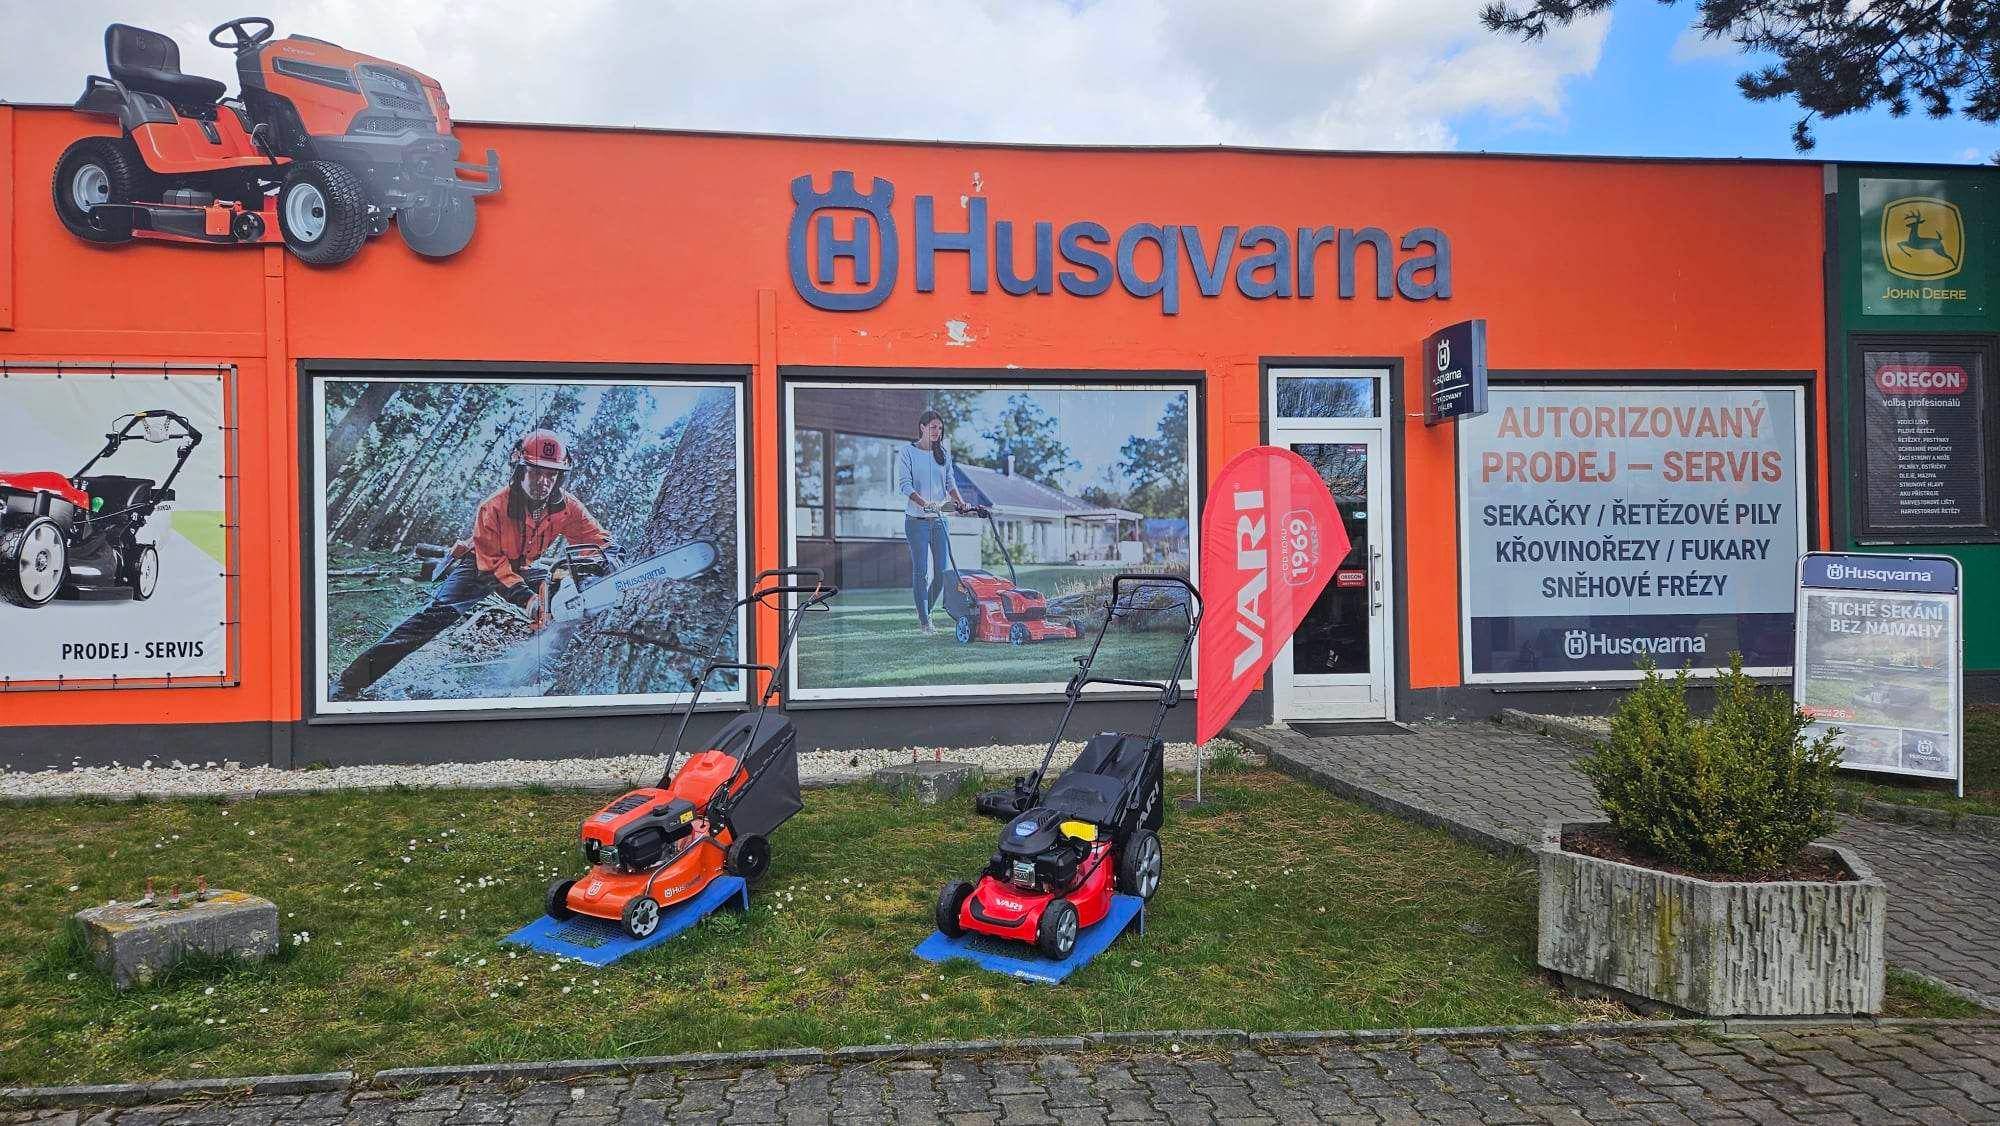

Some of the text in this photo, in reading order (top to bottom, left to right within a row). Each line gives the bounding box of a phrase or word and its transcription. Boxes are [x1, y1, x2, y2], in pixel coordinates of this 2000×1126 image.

[914, 194, 1452, 316] Husqvarna
[1882, 287, 1968, 300] JOHN DEERE
[1881, 371, 1960, 388] OREGON
[1883, 397, 1961, 409] volba profesionálů
[1497, 400, 1766, 438] AUTORIZOVANÝ
[1481, 451, 1617, 483] PRODEJ
[1663, 451, 1783, 482] SERVIS
[1483, 499, 1590, 527] SEKAČKY
[1612, 498, 1729, 525] ŘETĚZOVÉ
[1736, 503, 1782, 525] PILY
[1289, 518, 1309, 578] 1969
[1496, 535, 1660, 563] KŘOVINOŘEZY
[1681, 539, 1771, 561] FUKARY
[622, 566, 667, 590] Husqvarna
[1231, 490, 1268, 681] VARI
[1542, 570, 1728, 598] SNĚHOVÉ FRÉZY
[1845, 566, 1932, 582] Husqvarna
[1828, 600, 1943, 621] TICHÉ SEKÁNÍ
[1830, 618, 1942, 638] BEZ NÁMAHY
[62, 642, 129, 660] PRODEJ
[144, 641, 204, 659] SERVIS
[1590, 633, 1706, 655] Husqvarna
[996, 898, 1024, 911] VARI
